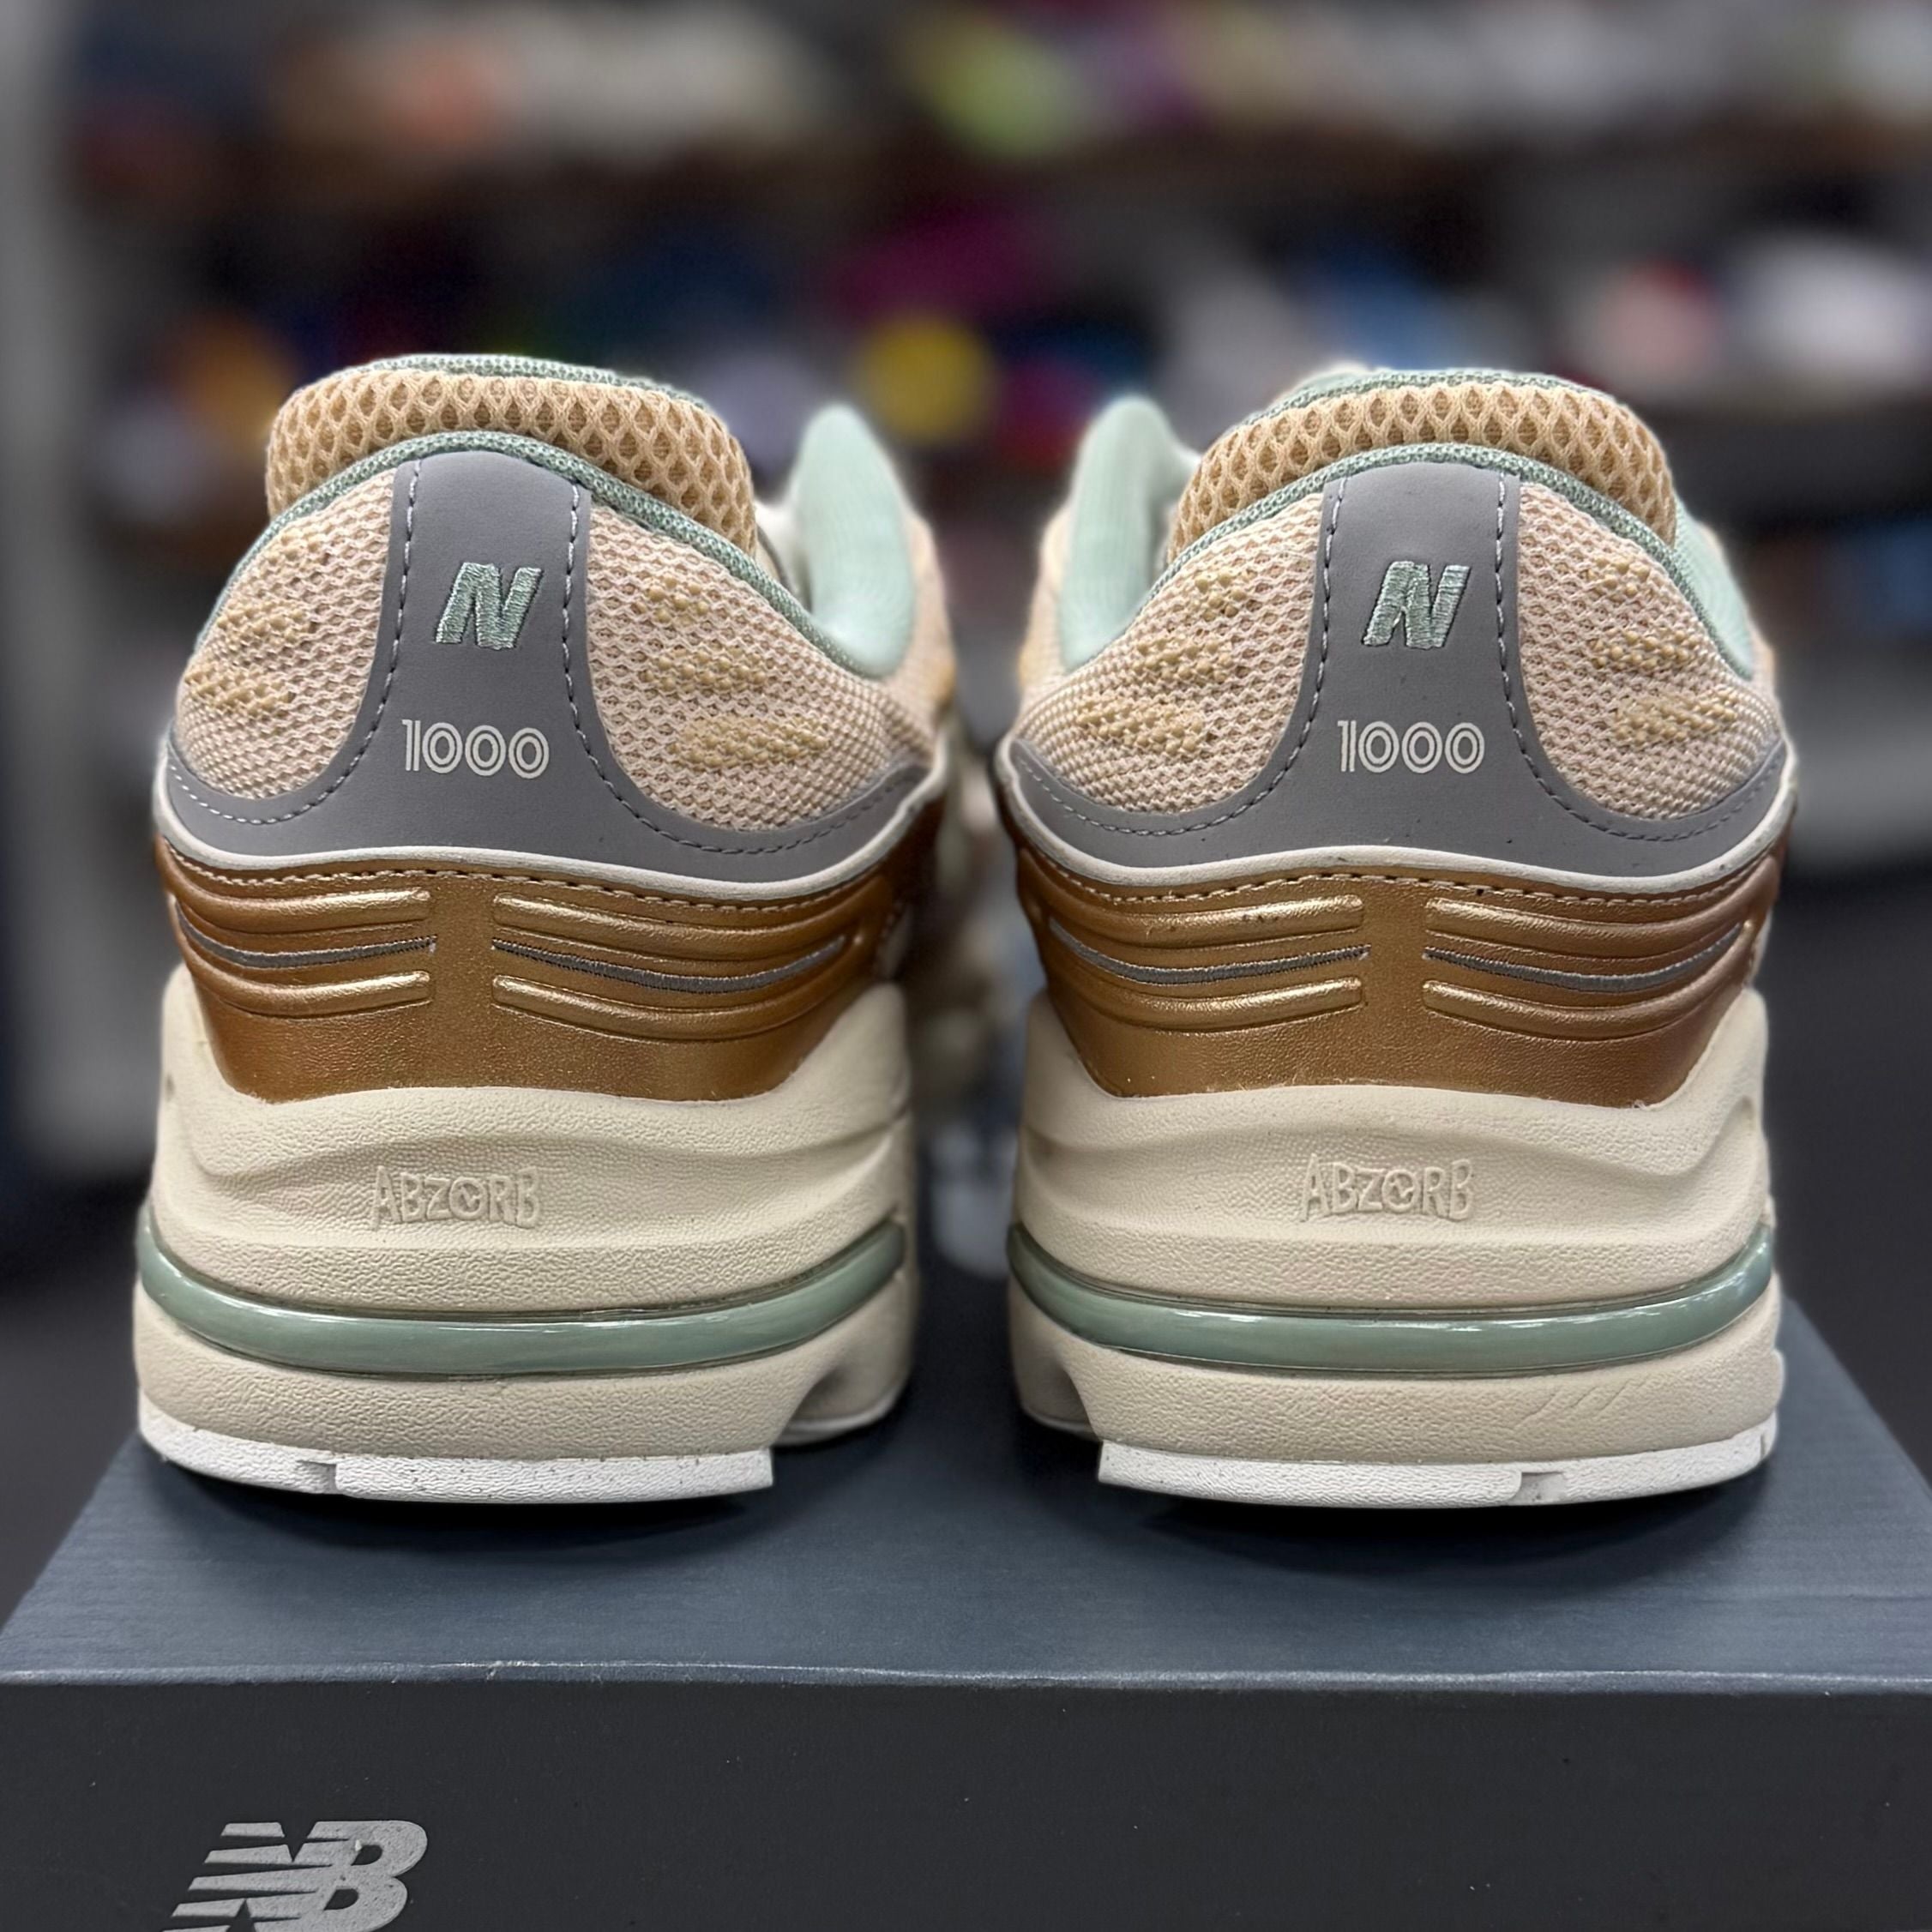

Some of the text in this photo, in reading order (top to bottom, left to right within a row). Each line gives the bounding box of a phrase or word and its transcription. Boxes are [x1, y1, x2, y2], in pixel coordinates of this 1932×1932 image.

[402, 719, 550, 779] 1000
[1337, 719, 1485, 773] 1000
[370, 1165, 540, 1231] ABZORB
[1299, 1153, 1473, 1223] ABZORB
[160, 1820, 428, 1932] NB
